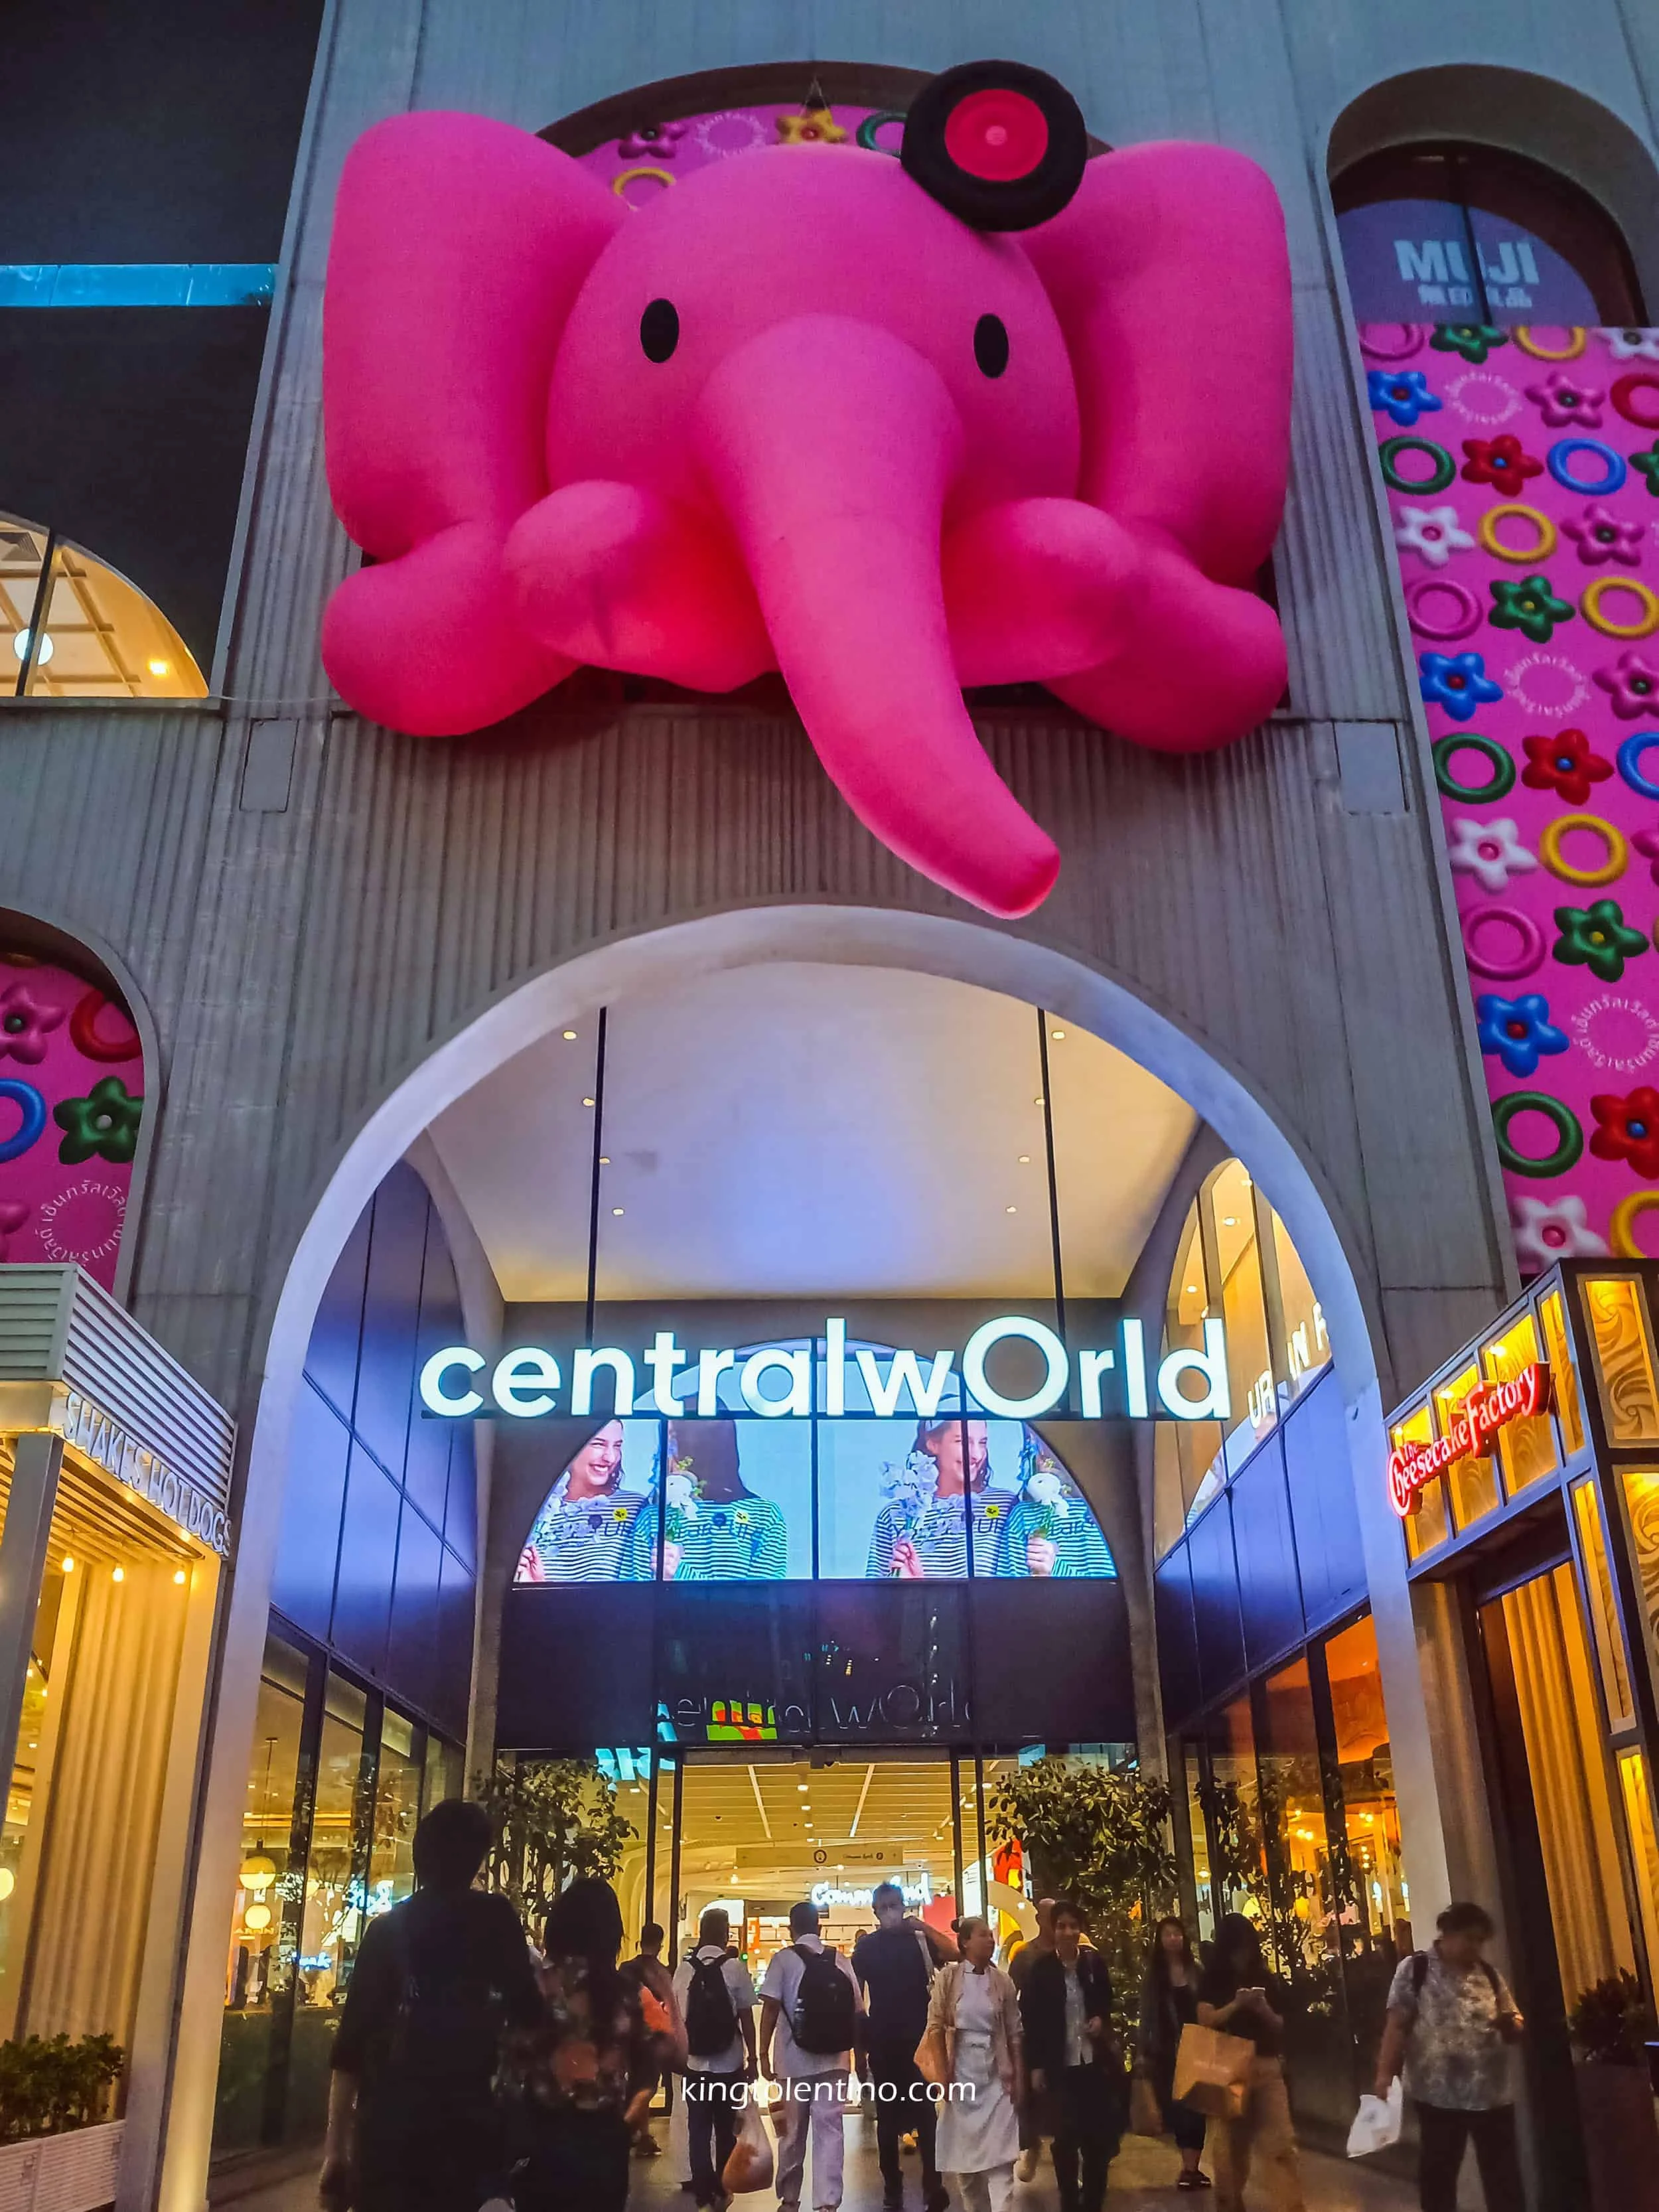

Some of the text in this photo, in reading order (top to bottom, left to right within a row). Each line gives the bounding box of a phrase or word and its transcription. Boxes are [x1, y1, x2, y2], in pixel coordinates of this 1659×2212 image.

[63, 1392, 232, 1557] SHAKES HOT DOGS
[1388, 1364, 1537, 1518] Cheesecake Factory
